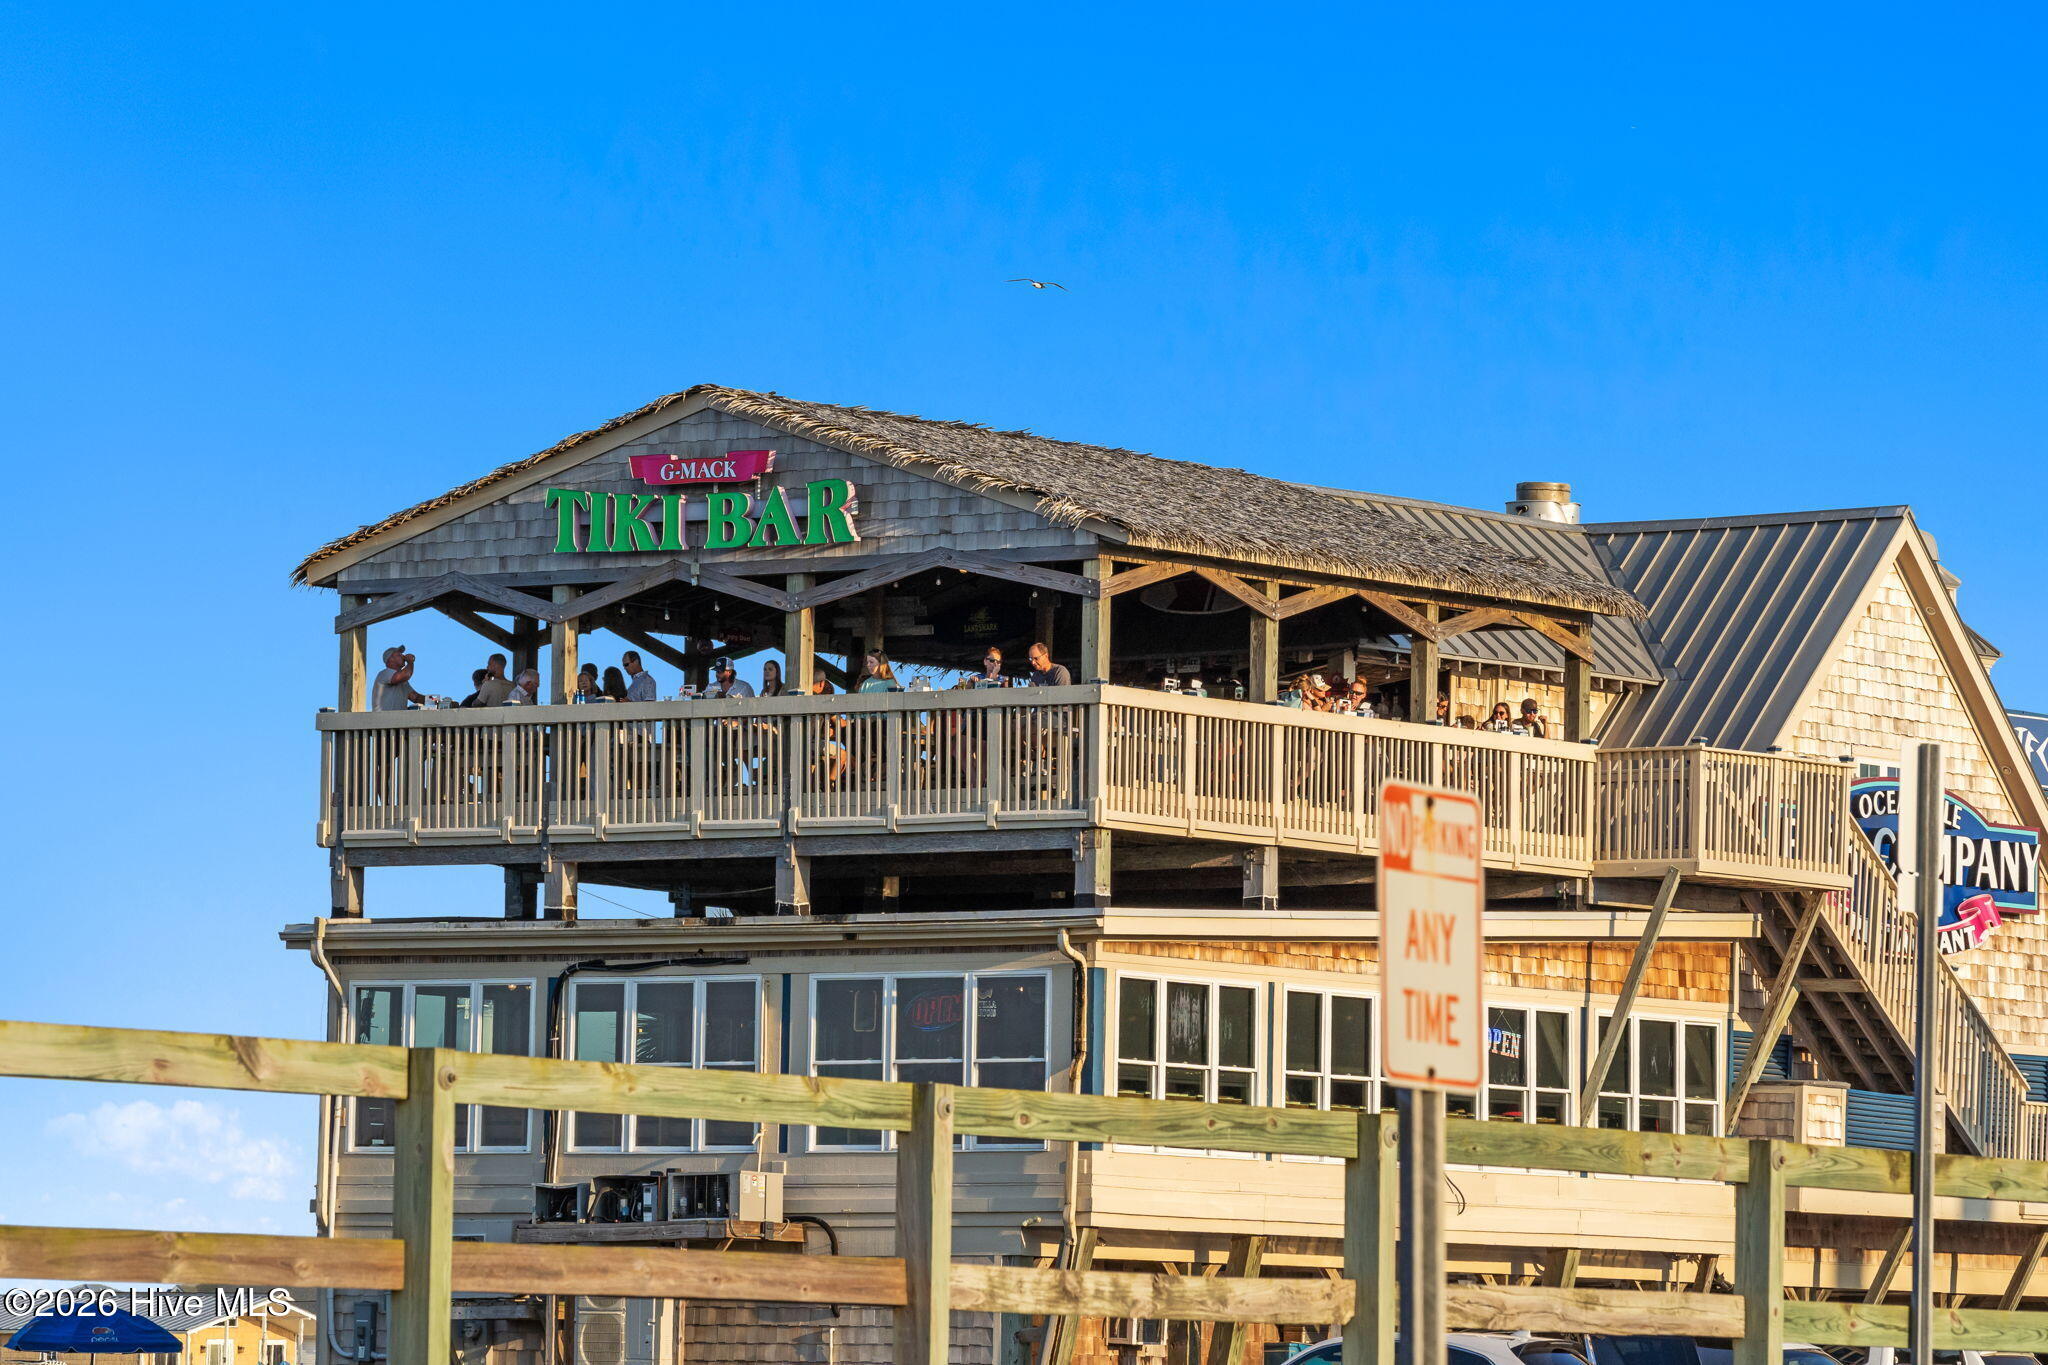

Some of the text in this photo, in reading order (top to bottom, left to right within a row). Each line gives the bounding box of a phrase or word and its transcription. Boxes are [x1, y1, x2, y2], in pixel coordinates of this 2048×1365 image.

[660, 460, 737, 481] G-MACK
[544, 478, 862, 552] TIKI BAR
[1384, 802, 1411, 859] NO
[1858, 790, 1901, 819] OCE
[1873, 827, 2042, 893] CPANY
[1403, 908, 1457, 966] ANY
[1402, 987, 1461, 1048] TIME
